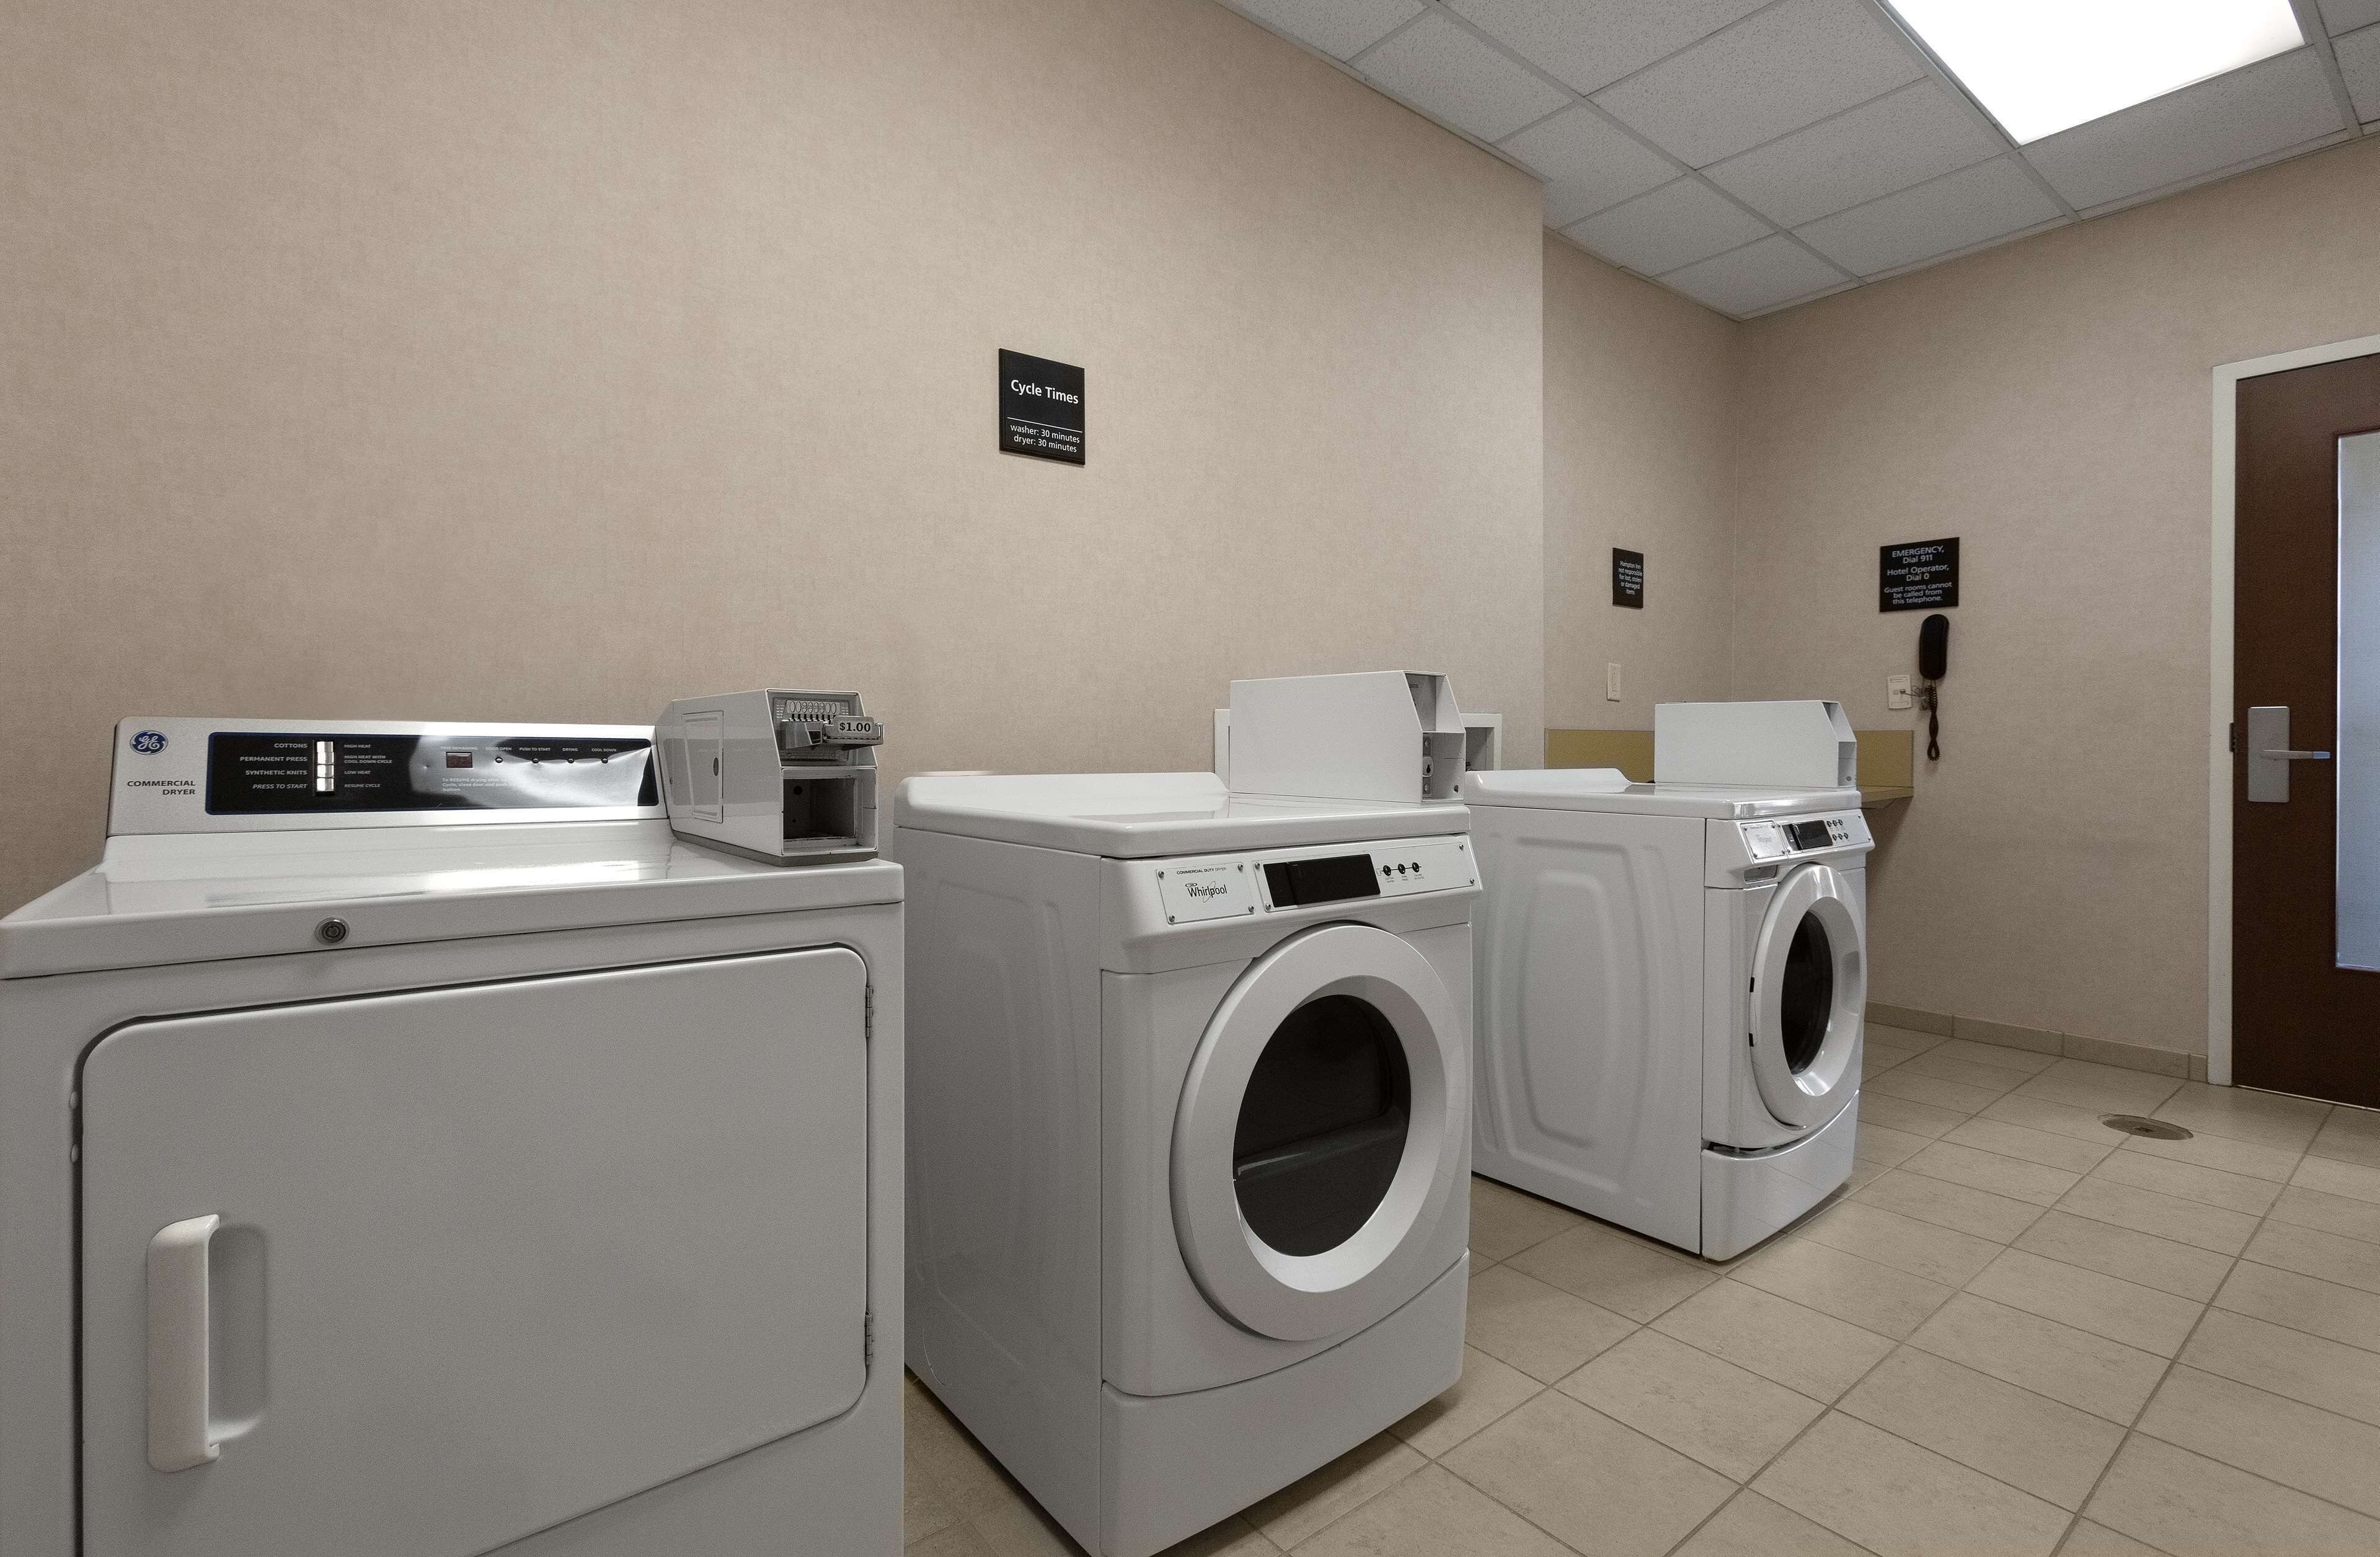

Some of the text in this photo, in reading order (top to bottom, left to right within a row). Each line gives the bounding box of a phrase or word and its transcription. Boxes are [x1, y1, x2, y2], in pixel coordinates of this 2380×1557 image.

[1011, 379, 1079, 404] Cycle Times
[1010, 424, 1080, 443] washer: 30 minutes
[1014, 434, 1077, 452] dryer: 30 minutes
[1892, 545, 1944, 558] EMERGENCY,
[1903, 554, 1933, 564] Dial 911
[1887, 565, 1949, 576] Hotel Operator,
[1906, 596, 1942, 604] telephone.
[839, 722, 871, 732] $1.00
[1187, 883, 1228, 899] Whirlpool
